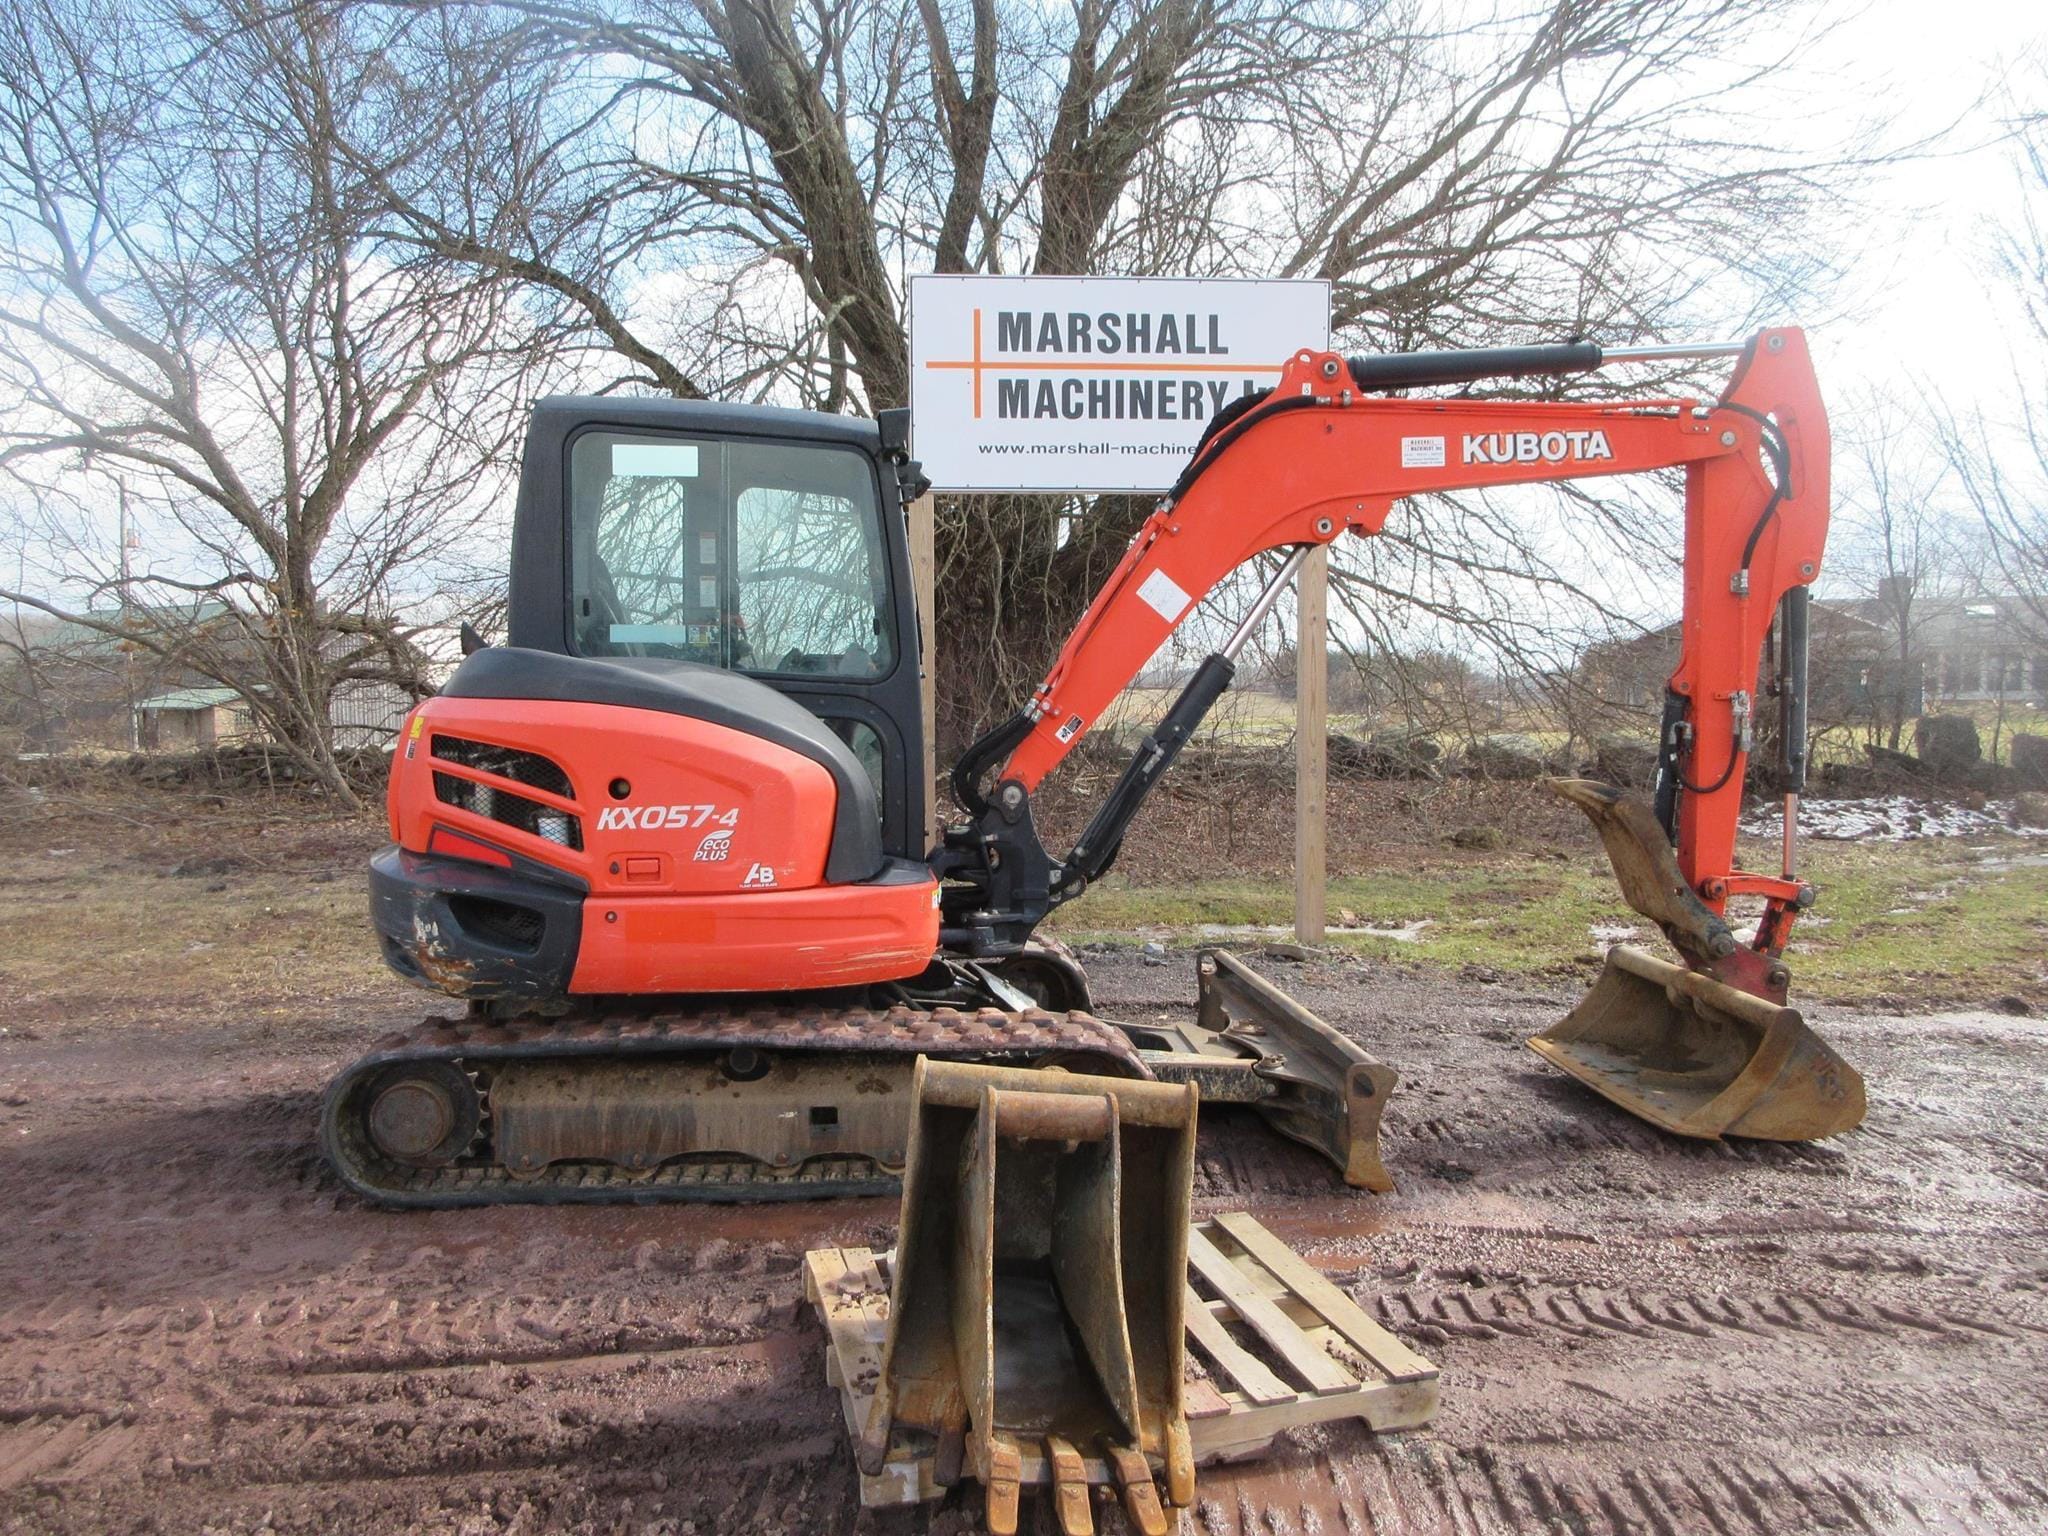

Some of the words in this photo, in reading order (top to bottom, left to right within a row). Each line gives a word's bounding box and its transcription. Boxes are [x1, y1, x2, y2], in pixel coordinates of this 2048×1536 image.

[998, 311, 1229, 355] MARSHALL
[998, 378, 1229, 420] MACHINERY
[978, 442, 1197, 455] www.marshall-machine
[1462, 430, 1612, 463] KUBOTA
[596, 804, 740, 831] KX057-4
[693, 850, 729, 861] PLUS
[703, 839, 730, 850] eco
[743, 862, 775, 884] AB
